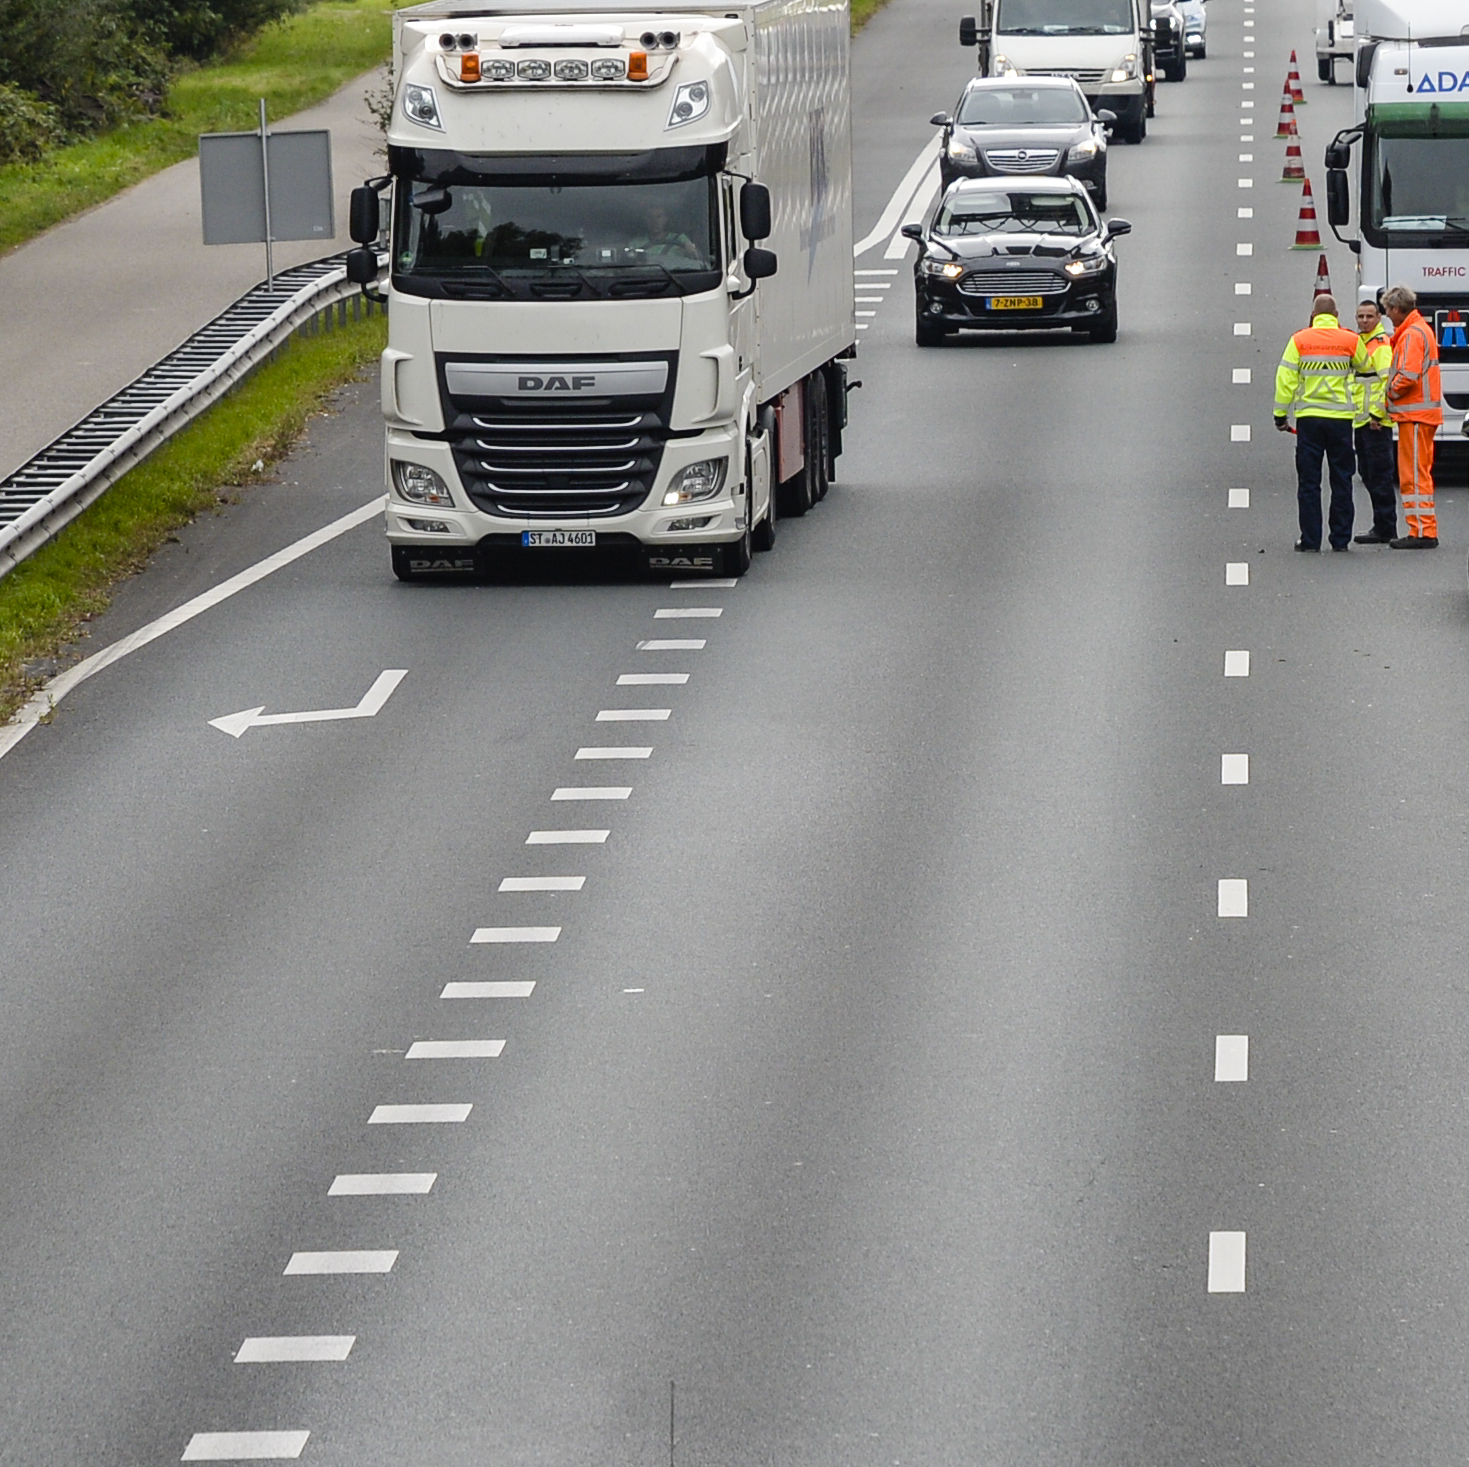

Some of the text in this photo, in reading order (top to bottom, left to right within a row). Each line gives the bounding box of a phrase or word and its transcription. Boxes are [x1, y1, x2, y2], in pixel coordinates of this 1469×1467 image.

[1422, 266, 1467, 277] TRAFFIC
[517, 376, 596, 391] DAF
[529, 532, 594, 545] ST AJ 4601
[409, 559, 474, 569] DAF
[649, 556, 713, 567] DAF
